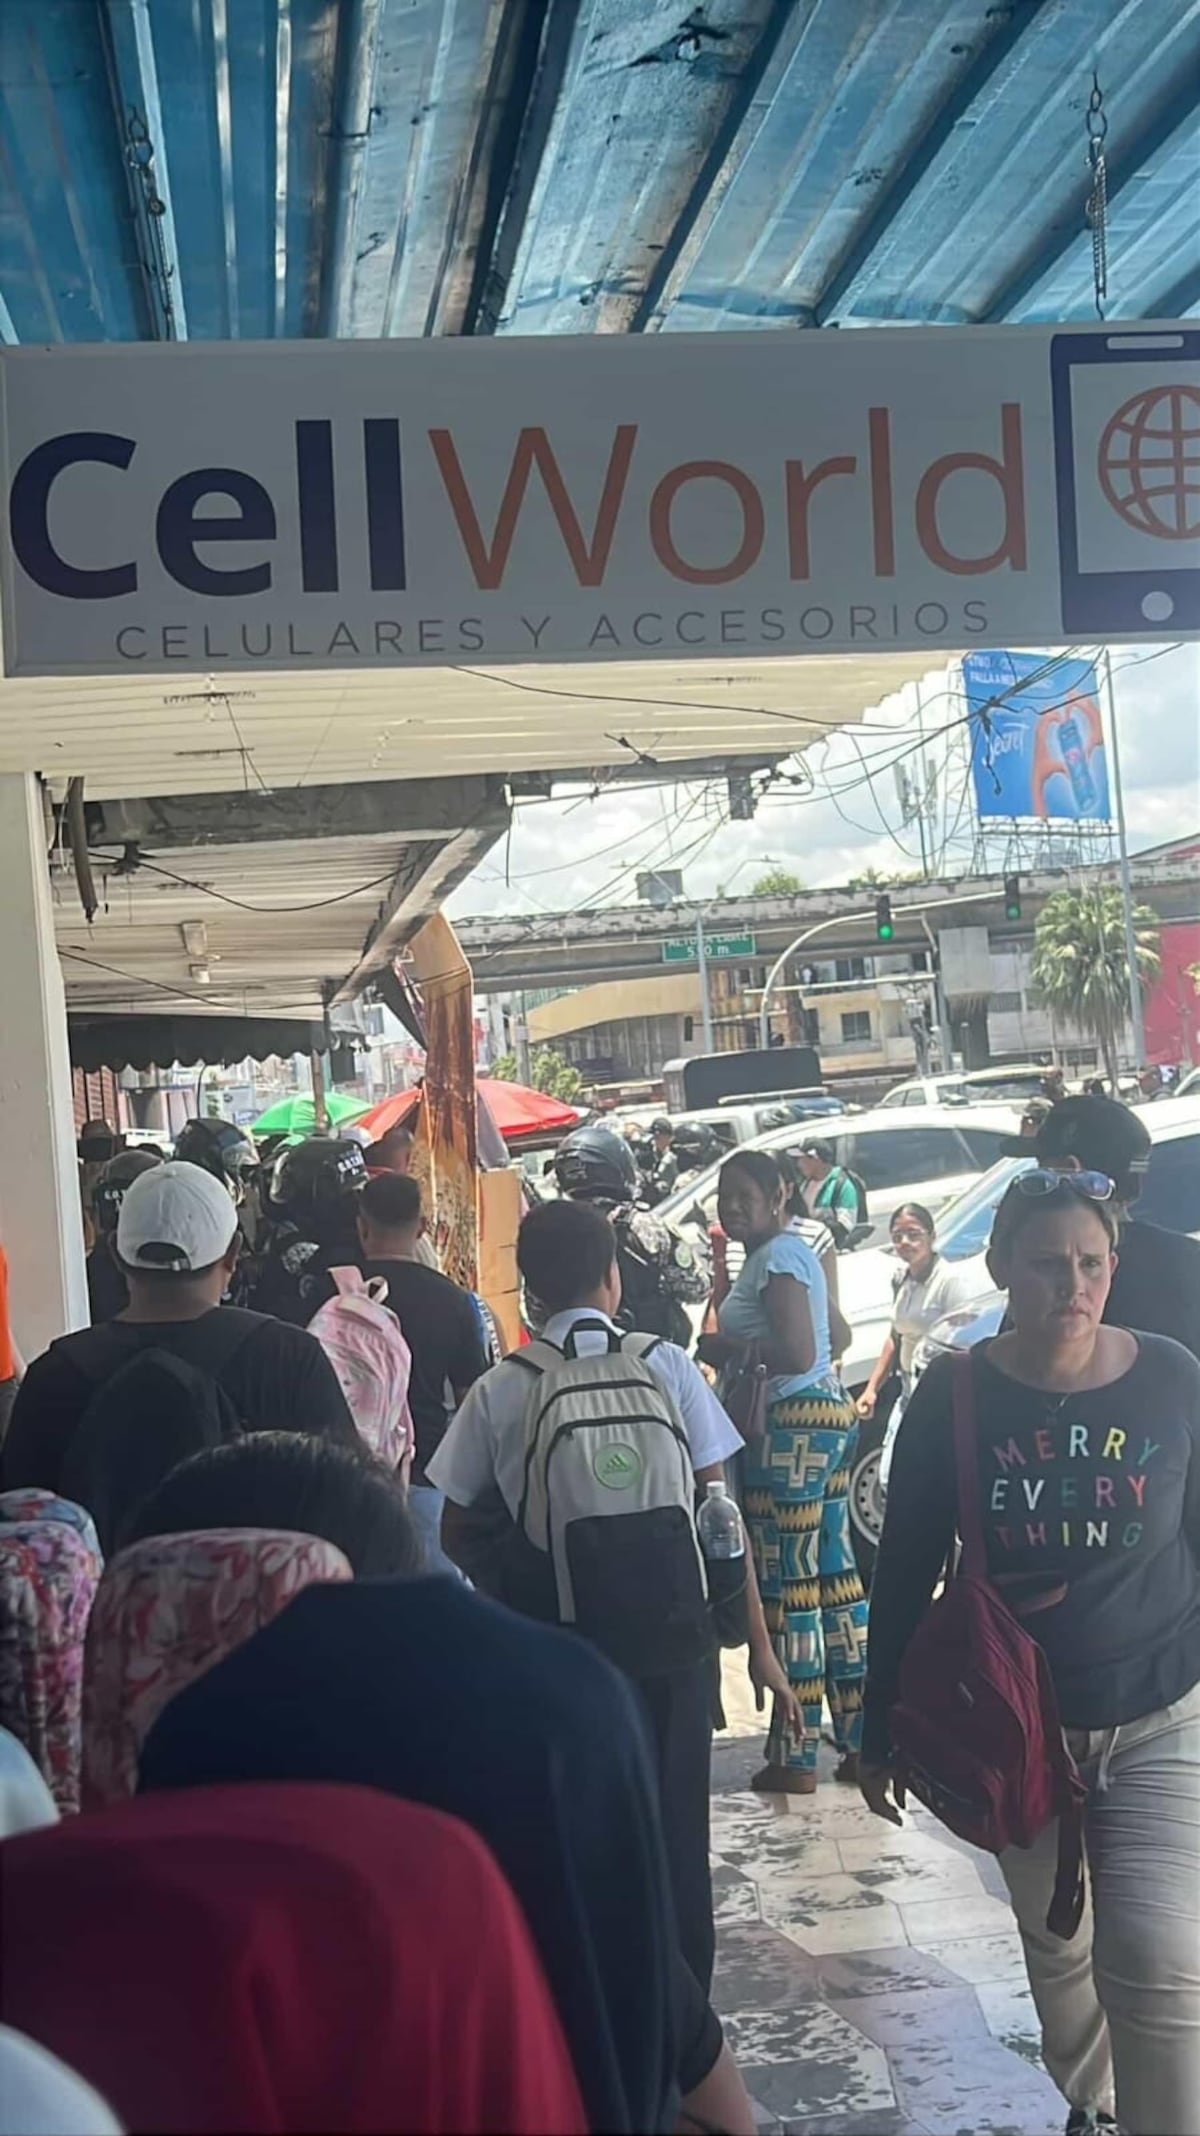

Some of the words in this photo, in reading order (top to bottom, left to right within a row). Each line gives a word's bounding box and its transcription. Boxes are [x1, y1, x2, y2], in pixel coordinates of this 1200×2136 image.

[10, 403, 1027, 600] CellWorld
[116, 617, 484, 660] CELULARES
[522, 615, 551, 648] Y
[589, 601, 988, 647] ACCESORIOS
[993, 1424, 1160, 1472] MERRY
[991, 1475, 1147, 1510] EVERY
[995, 1520, 1143, 1551] THING
